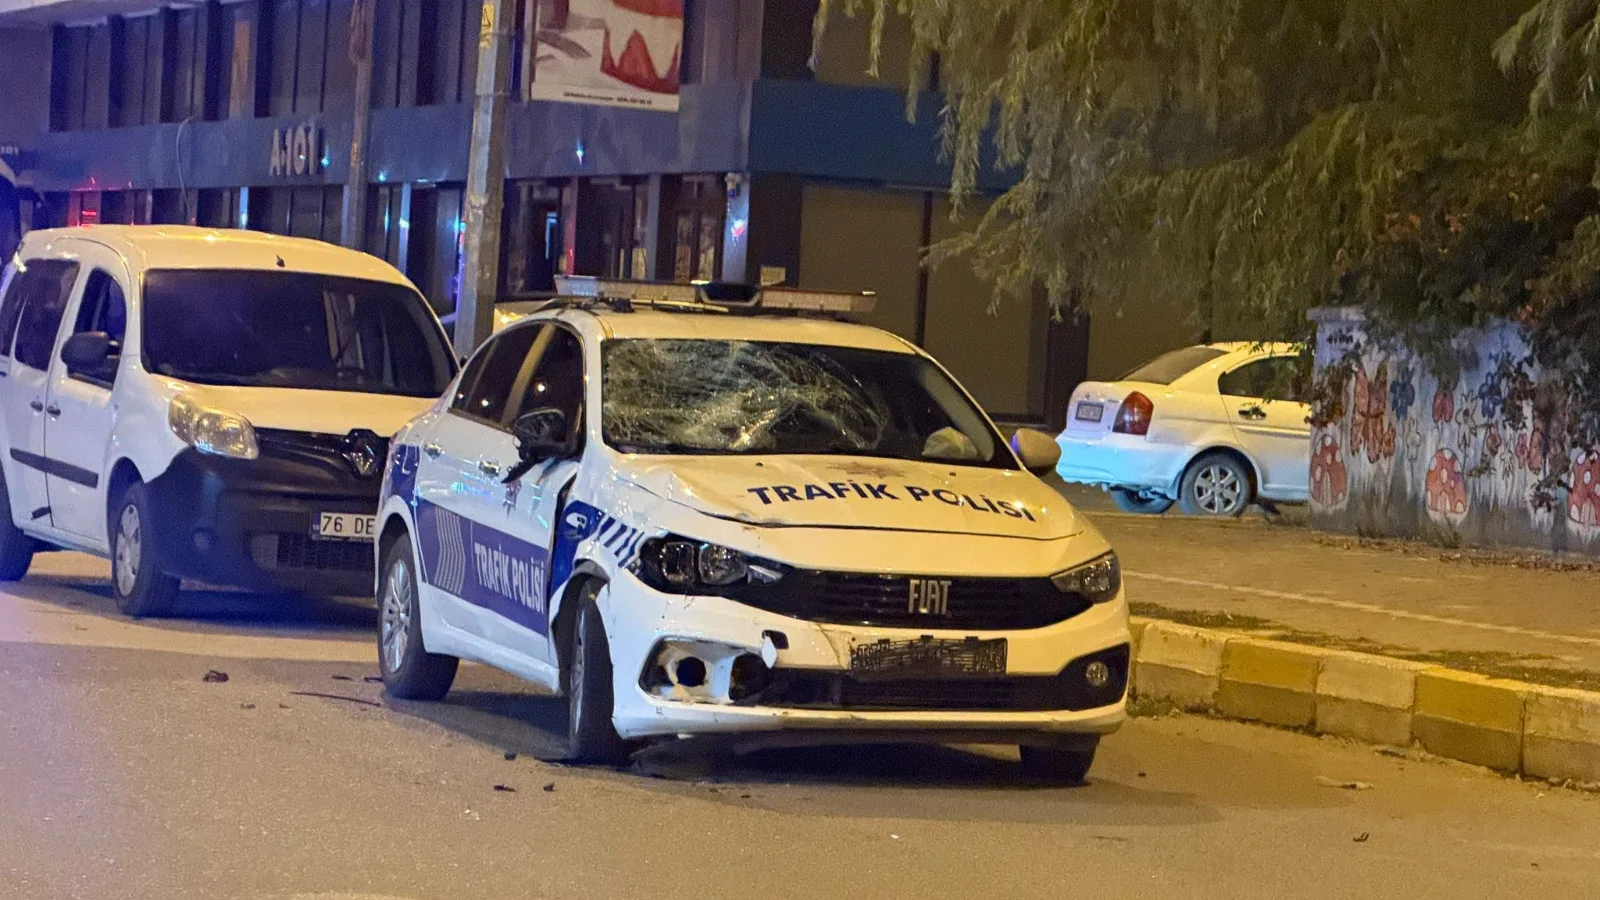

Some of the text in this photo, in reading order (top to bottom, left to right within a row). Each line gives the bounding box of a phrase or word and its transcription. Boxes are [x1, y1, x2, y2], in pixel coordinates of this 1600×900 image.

[746, 479, 900, 505] TRAFİK
[323, 514, 375, 535] 76 DE
[474, 543, 544, 614] TRAFİK POLİSİ
[908, 579, 952, 616] FIAT
